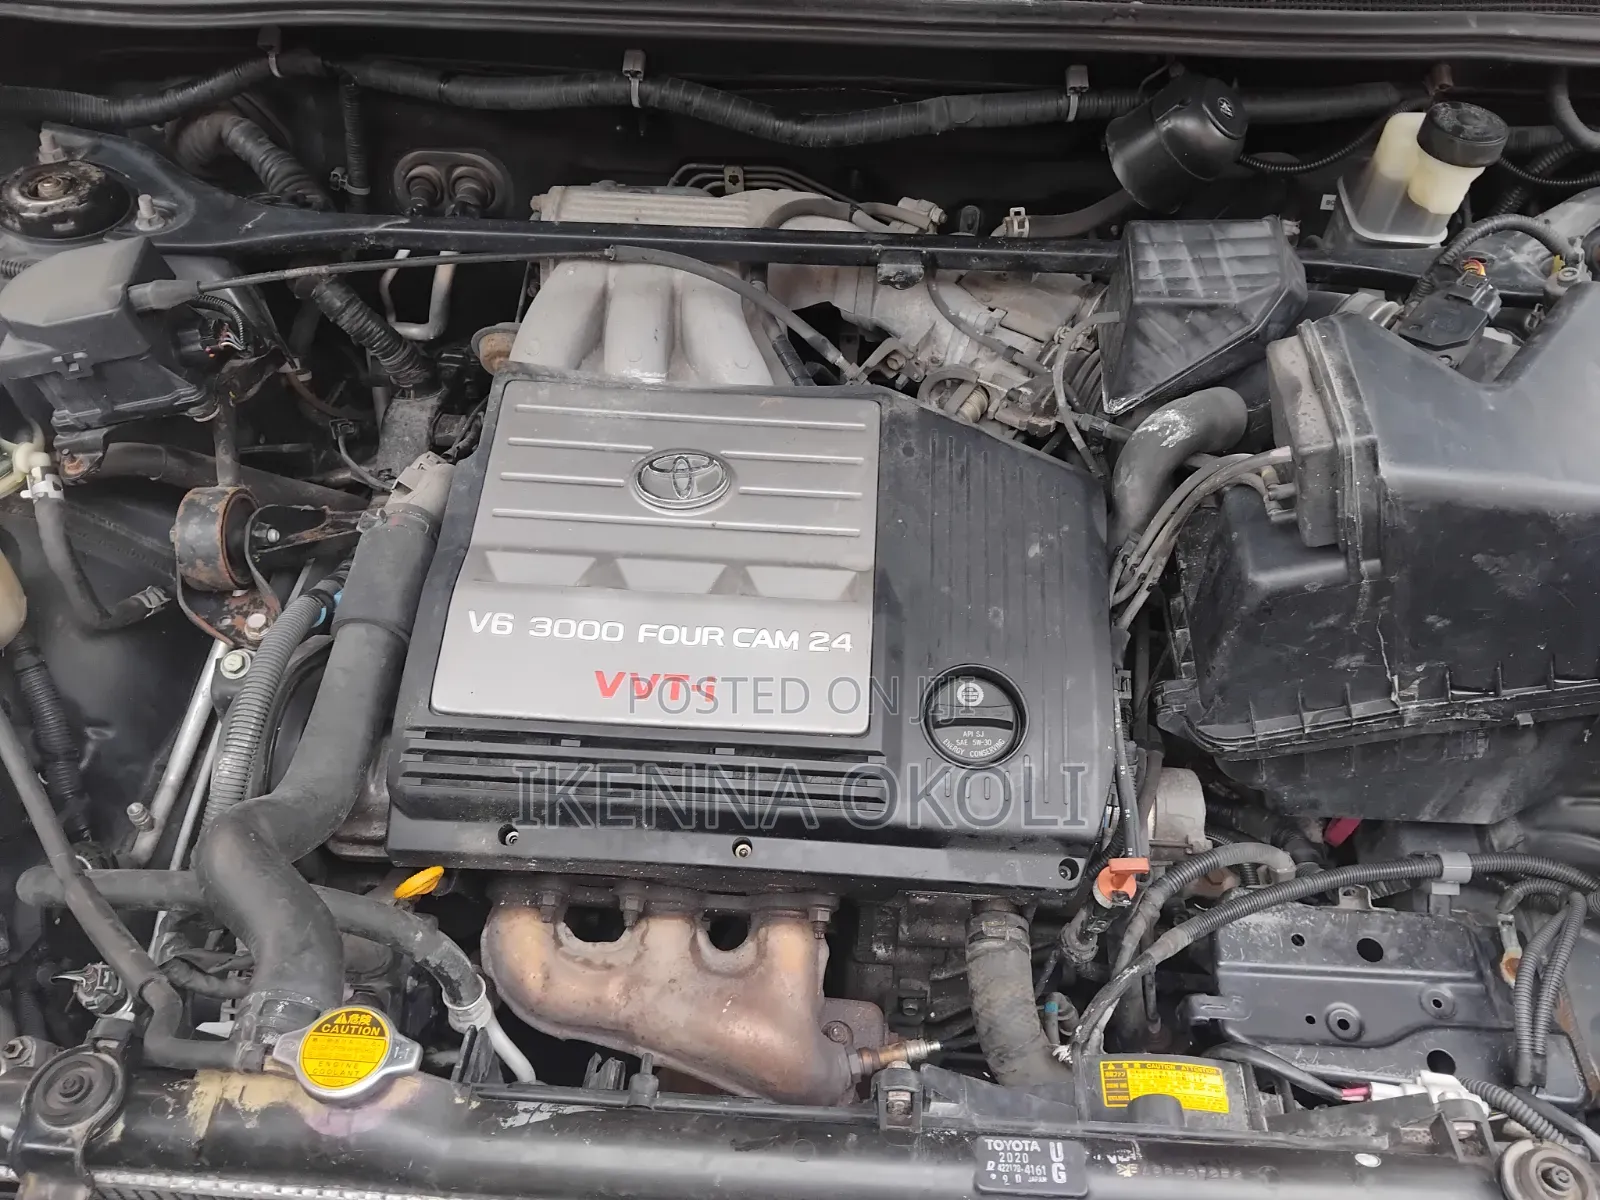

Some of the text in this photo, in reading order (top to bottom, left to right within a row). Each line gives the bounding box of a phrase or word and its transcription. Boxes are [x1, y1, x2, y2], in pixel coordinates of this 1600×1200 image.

[467, 610, 853, 653] V6 3000 FOUR CAM 24
[594, 670, 717, 703] VVT-i
[943, 738, 1006, 758] ENERGY CONSERVING
[321, 1024, 381, 1036] CAUTION
[318, 1061, 360, 1070] ENGINE
[1181, 1065, 1217, 1074] ATTENTION
[312, 1068, 361, 1077] COOLANT
[984, 1139, 1041, 1152] TOYOTA
[999, 1152, 1029, 1164] 2020
[1049, 1141, 1067, 1184] U G
